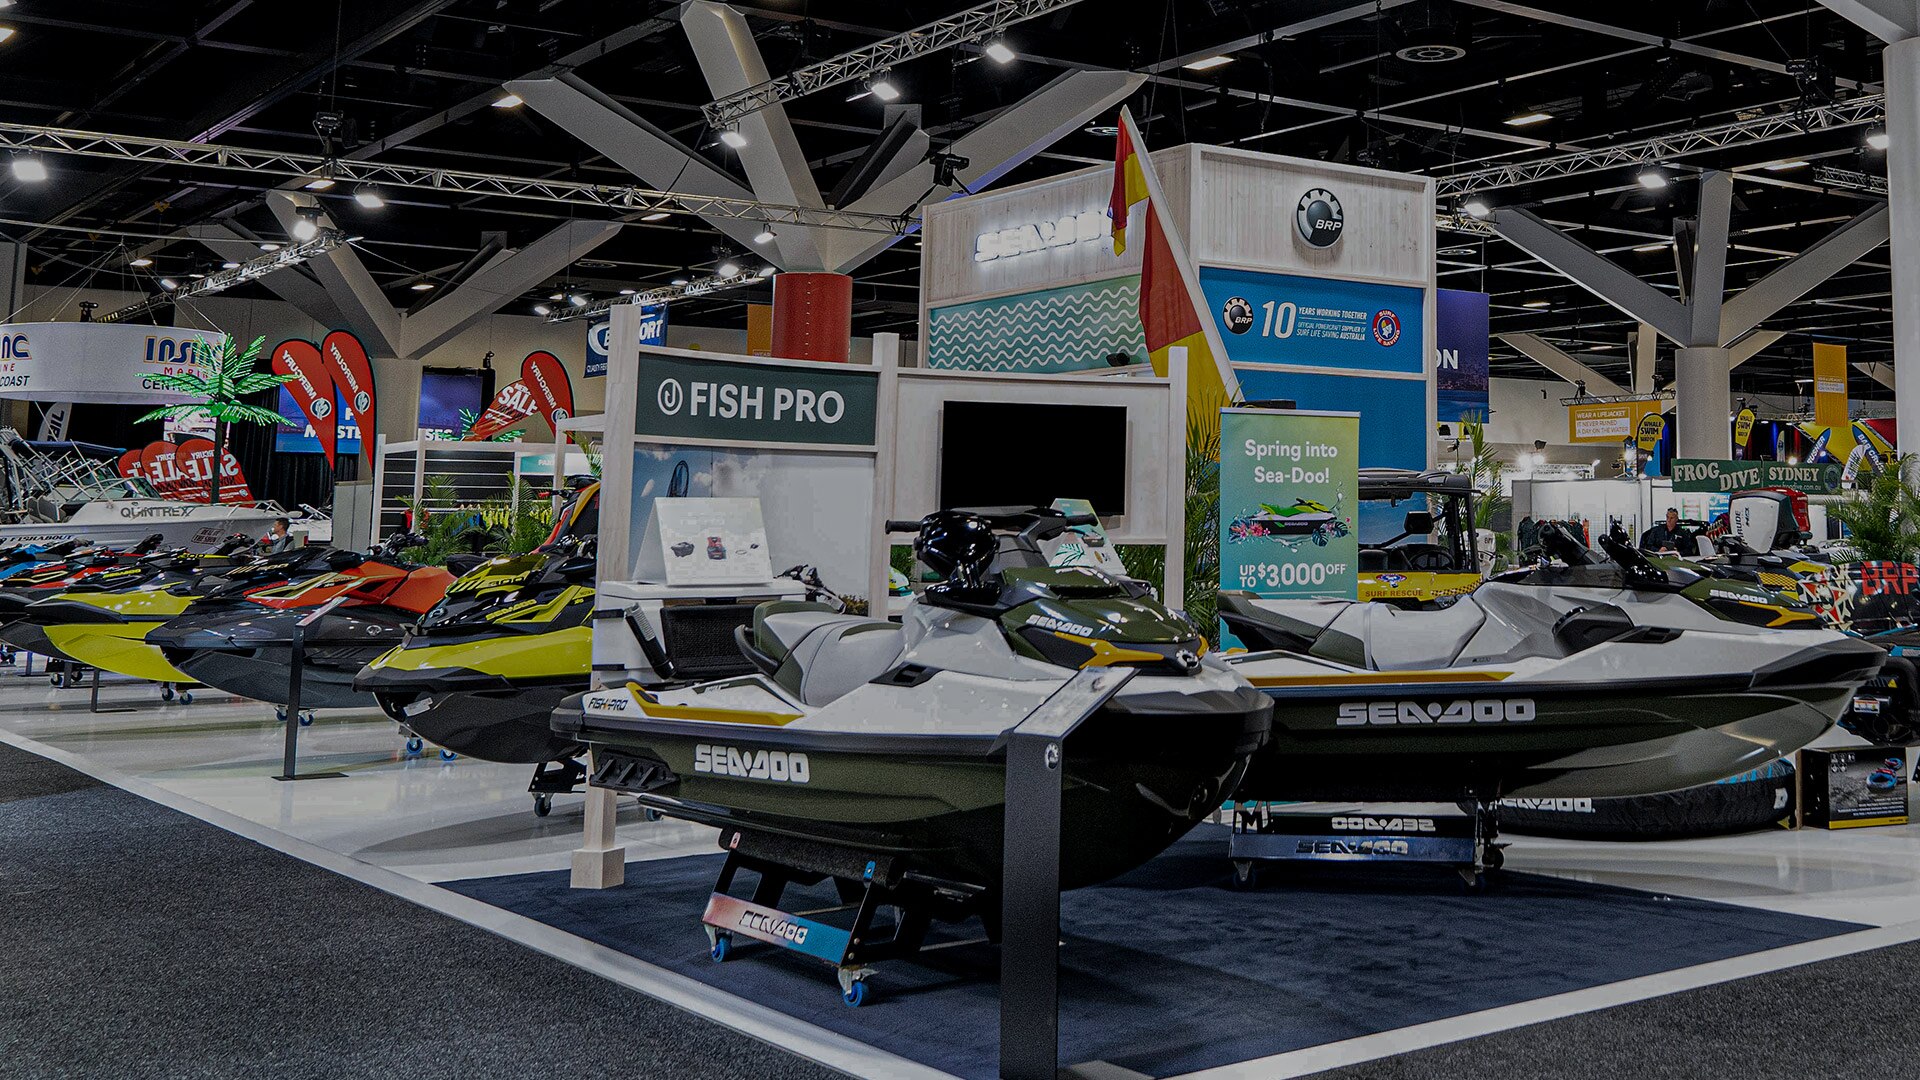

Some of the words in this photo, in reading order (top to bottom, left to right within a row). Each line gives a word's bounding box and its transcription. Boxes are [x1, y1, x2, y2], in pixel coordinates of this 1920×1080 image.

[1316, 219, 1343, 231] BRP
[1262, 300, 1297, 339] 10
[1298, 306, 1316, 316] YEARS
[1316, 308, 1341, 318] WORKING
[1341, 310, 1368, 320] TOGETHER
[1234, 316, 1253, 325] BRP
[1298, 321, 1315, 329] OFFICIAL
[1315, 322, 1342, 331] POWERCRAFT
[1341, 325, 1361, 333] SUPPLIER
[1310, 329, 1321, 338] LIFE
[1321, 330, 1340, 339] SAVING
[1340, 331, 1366, 341] AUSTRALIA
[690, 381, 764, 420] FISH
[773, 387, 846, 424] PRO
[1597, 410, 1626, 418] LIFEJACKET
[1640, 427, 1659, 435] SWIM
[1245, 439, 1302, 461] Spring
[1305, 441, 1338, 458] into
[1254, 466, 1330, 484] Sea-Doo!
[1673, 462, 1720, 482] FROG
[1719, 467, 1761, 491] DIVE
[1768, 467, 1820, 481] SYDNEY
[121, 506, 192, 518] QUINTREX
[1239, 564, 1256, 576] UP
[1257, 562, 1326, 588] $3,000
[1326, 563, 1346, 575] OFF
[1239, 577, 1257, 588] TO
[1860, 561, 1920, 596] BRP
[588, 697, 607, 709] FISH
[607, 699, 629, 711] PRO
